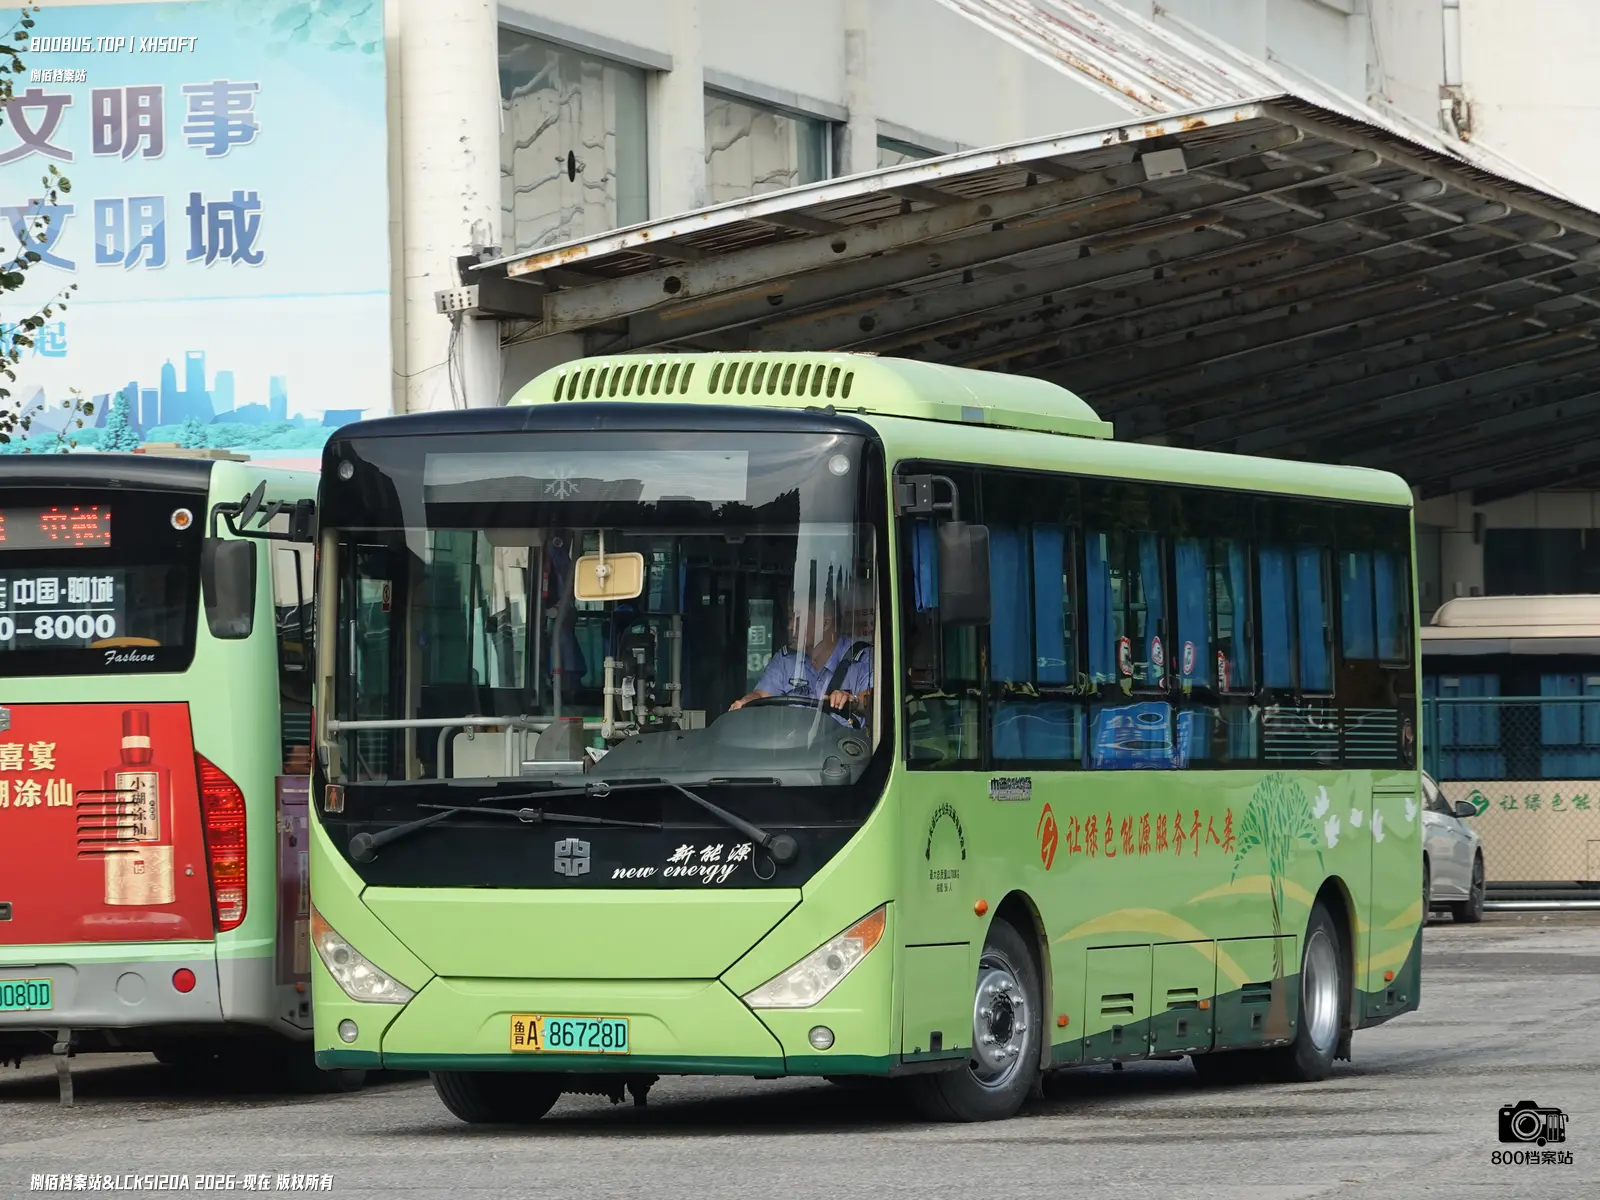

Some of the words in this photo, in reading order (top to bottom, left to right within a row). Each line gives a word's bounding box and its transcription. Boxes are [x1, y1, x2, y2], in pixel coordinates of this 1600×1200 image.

[0, 80, 261, 162] 文明事
[0, 190, 265, 271] 文明城
[0, 614, 116, 641] 0-8000
[104, 649, 155, 665] Fashion
[0, 741, 57, 771] 喜宴
[1066, 807, 1236, 858] 让绿色能源服务于人类
[666, 842, 752, 865] 新能源
[611, 866, 659, 880] new
[663, 863, 739, 884] energy
[0, 983, 50, 1006] 080D
[514, 1020, 539, 1046] 鲁A
[549, 1021, 626, 1048] 86728D
